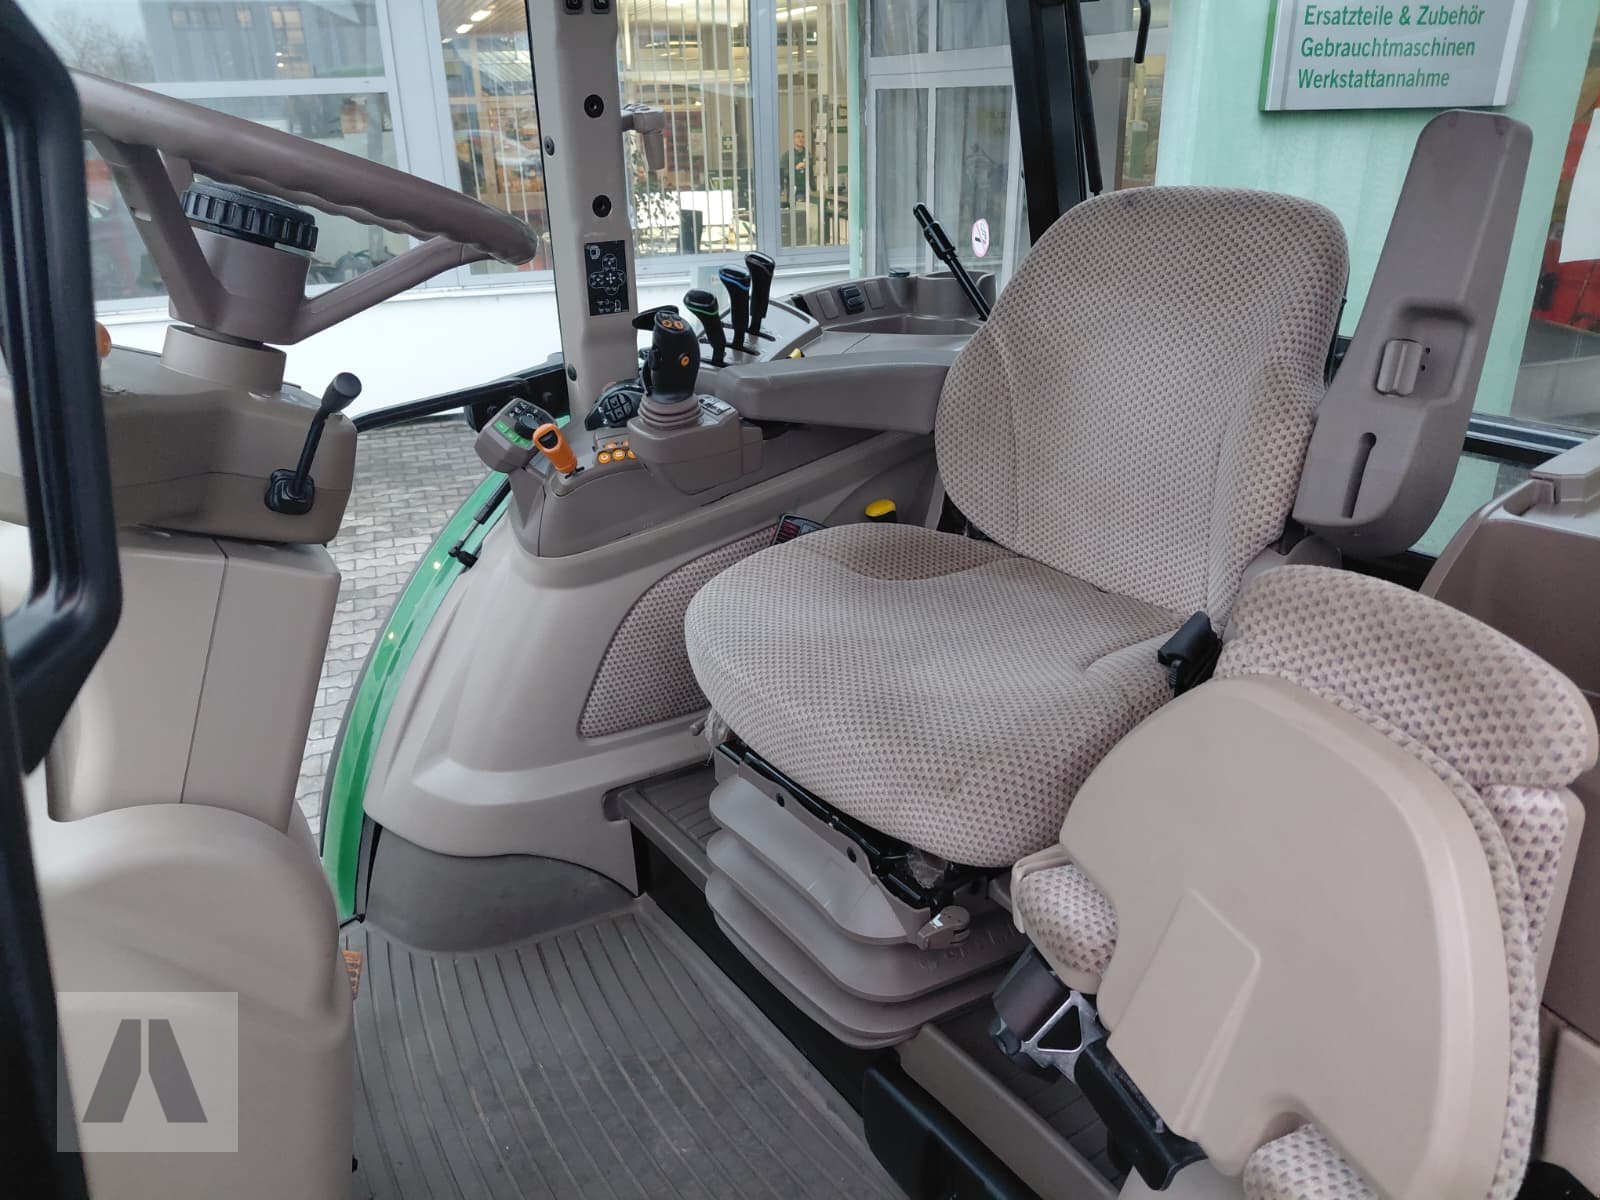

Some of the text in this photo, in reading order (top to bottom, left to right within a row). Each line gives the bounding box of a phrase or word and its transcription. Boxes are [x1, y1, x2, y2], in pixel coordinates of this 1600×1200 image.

[1304, 5, 1485, 25] Ersatzteile & Zubehör
[1301, 37, 1475, 57] Gebrauchtmaschinen
[1298, 69, 1449, 88] Werkstattannahme
